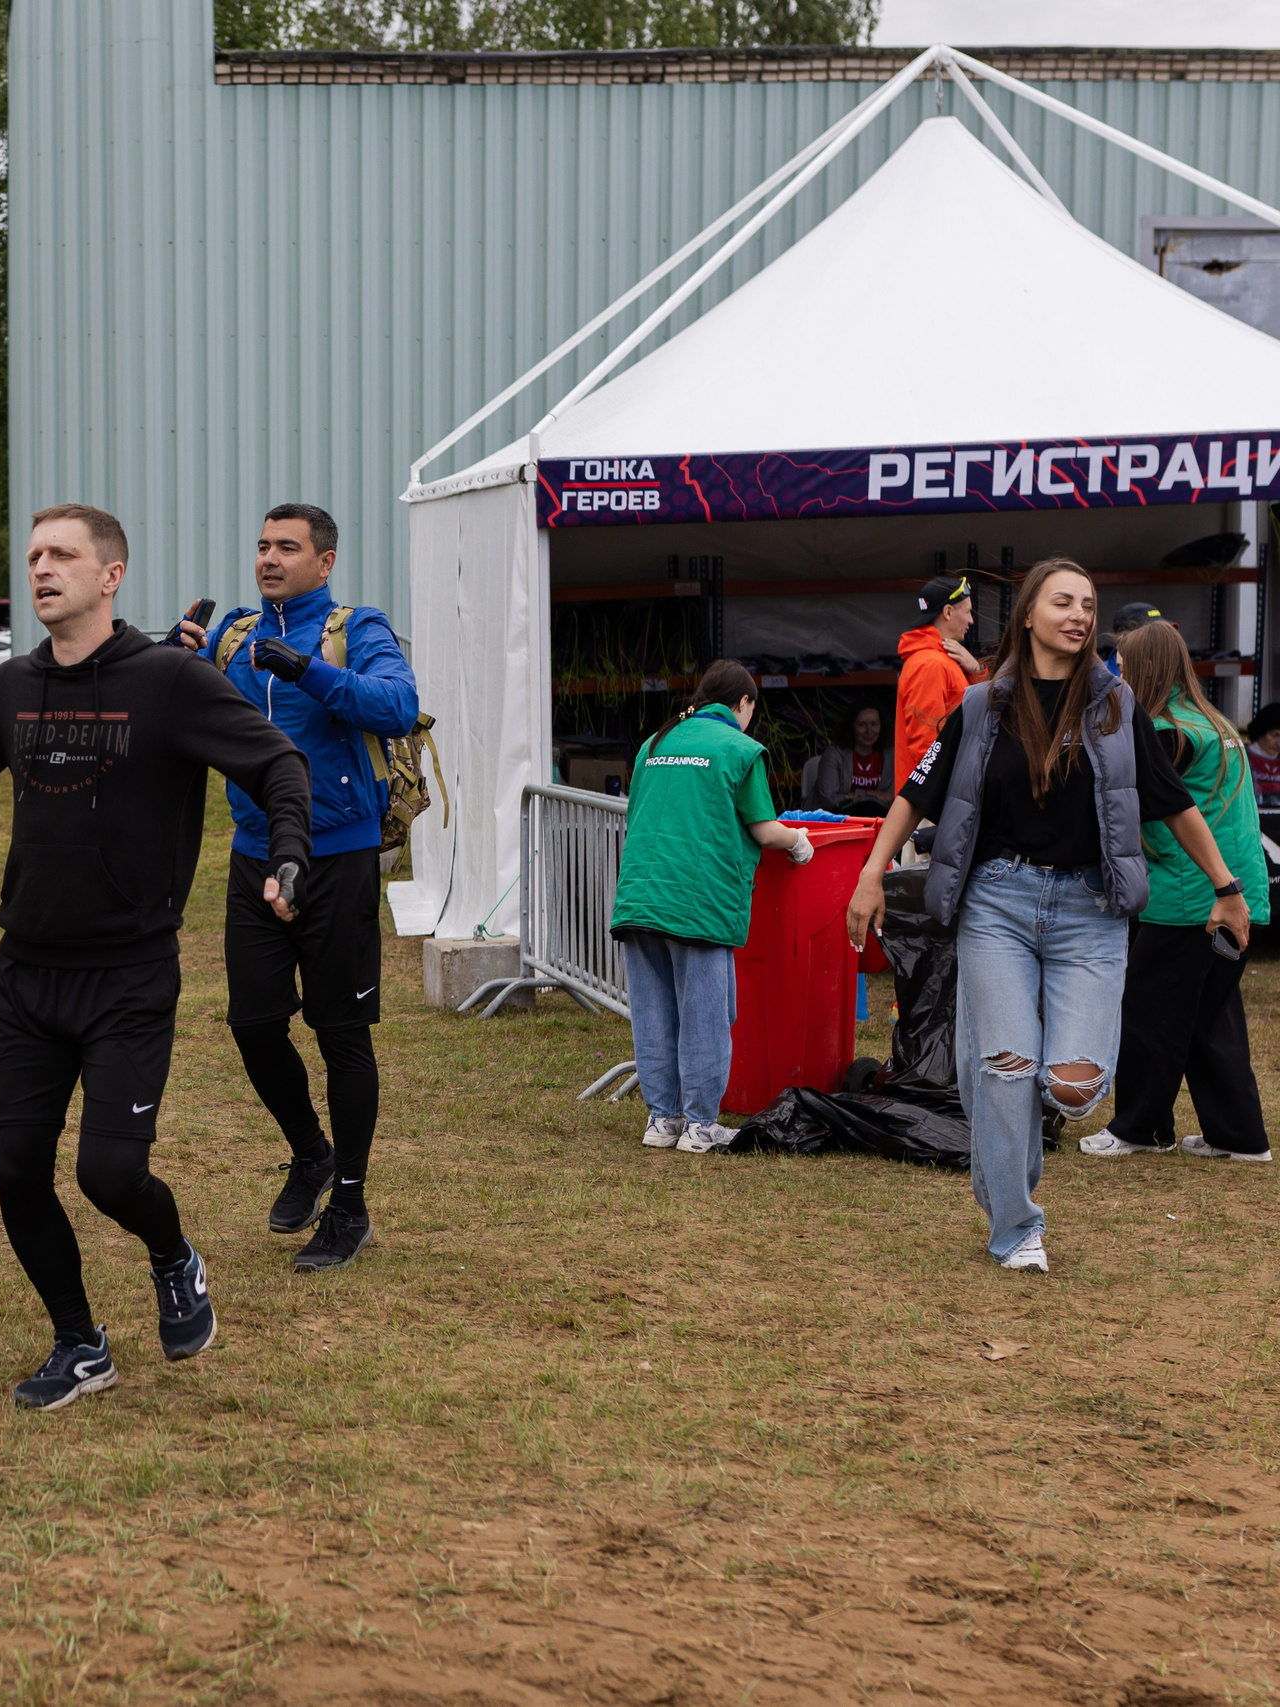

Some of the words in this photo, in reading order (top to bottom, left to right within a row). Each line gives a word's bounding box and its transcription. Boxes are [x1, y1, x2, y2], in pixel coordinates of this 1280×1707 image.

[569, 459, 656, 481] ГОНКА
[867, 439, 1280, 500] РЕГИСТРАЦИ
[561, 489, 661, 511] ГЕРОЕВ
[53, 711, 74, 721] 1993
[24, 753, 50, 761] HADEST
[644, 755, 710, 768] PROCLEANING24
